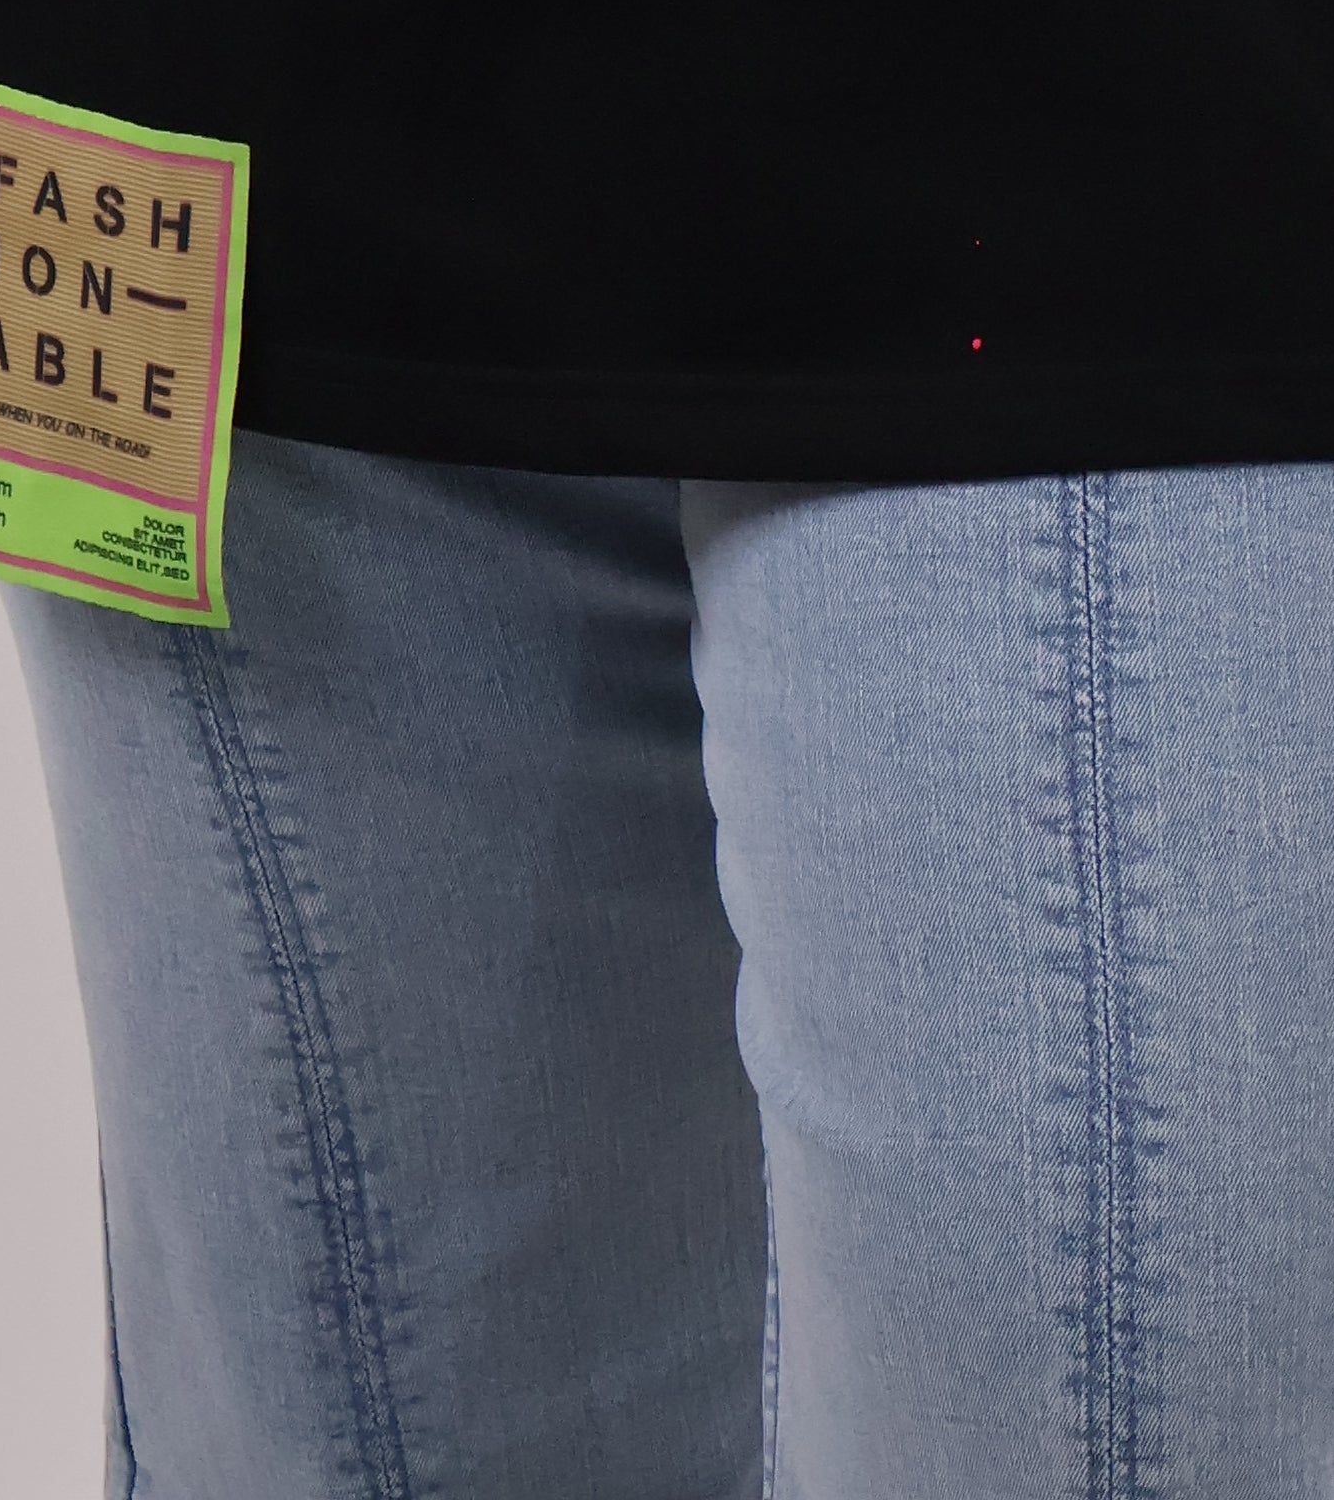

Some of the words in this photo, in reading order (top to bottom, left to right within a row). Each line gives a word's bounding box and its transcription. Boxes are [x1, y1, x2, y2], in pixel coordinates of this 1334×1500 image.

[36, 413, 63, 432] YOU
[65, 422, 85, 439] ON
[89, 427, 112, 448] THE
[143, 515, 184, 537] DOLOR
